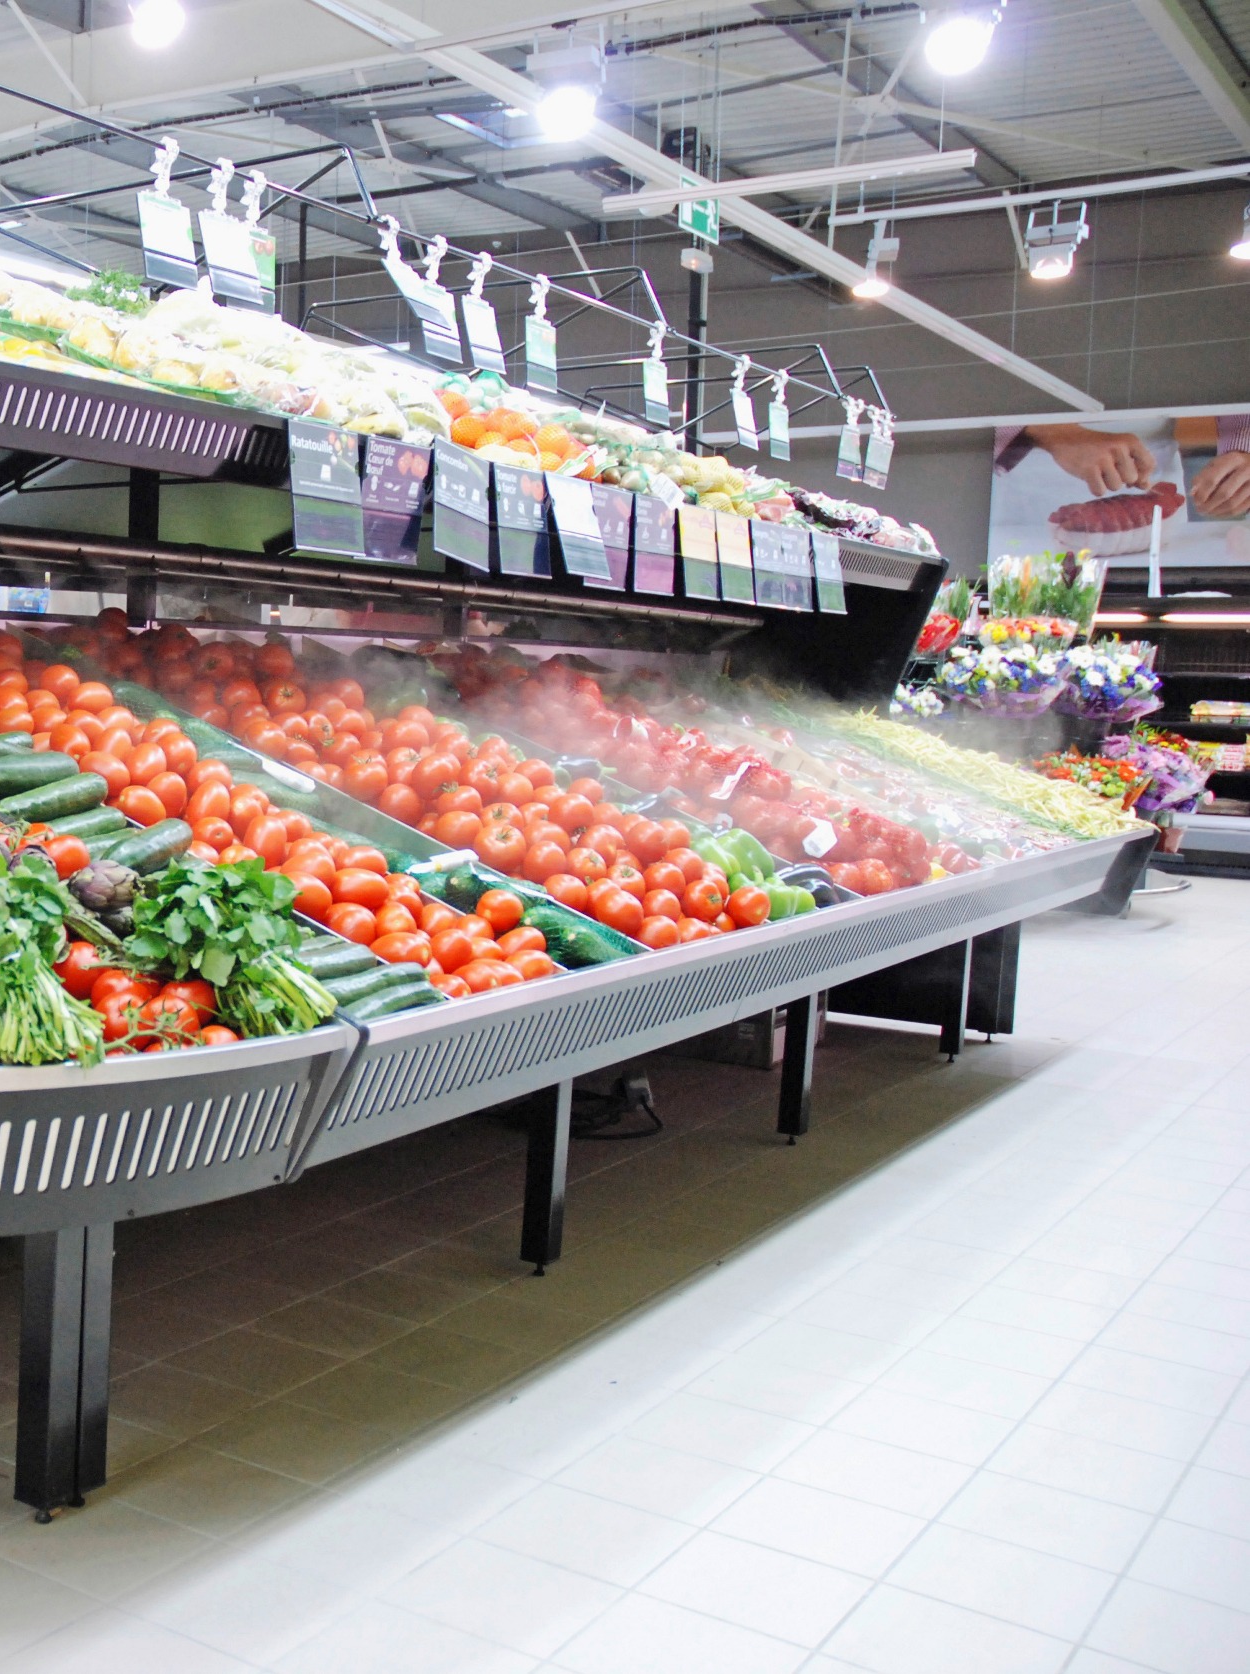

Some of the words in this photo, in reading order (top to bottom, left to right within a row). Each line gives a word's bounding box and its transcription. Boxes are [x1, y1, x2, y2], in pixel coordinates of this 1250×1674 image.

[291, 435, 333, 454] Ratatouille
[370, 440, 396, 456] Tomate
[385, 456, 394, 467] de
[436, 449, 469, 473] Concombre
[496, 469, 517, 483] Tomate
